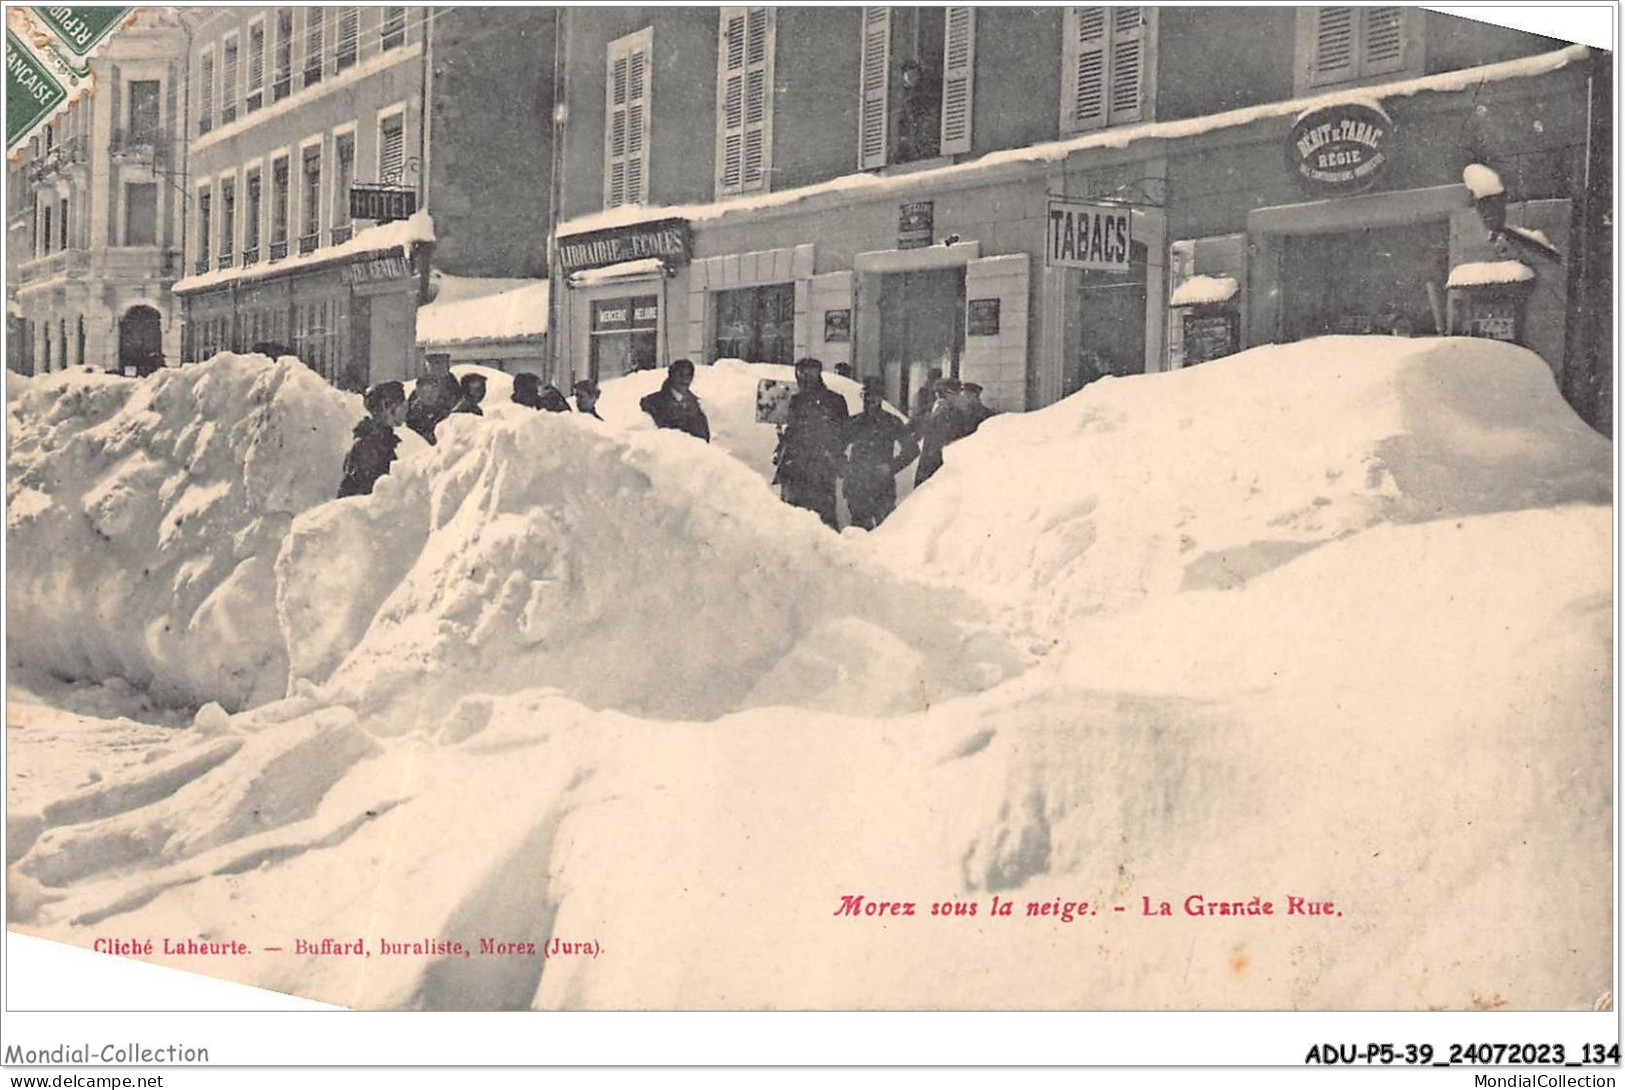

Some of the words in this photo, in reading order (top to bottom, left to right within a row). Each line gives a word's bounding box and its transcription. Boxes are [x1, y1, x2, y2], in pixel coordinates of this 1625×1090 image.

[1340, 119, 1383, 149] TABAC
[1050, 209, 1127, 263] TABACS
[560, 238, 621, 269] LIBRAIRIE
